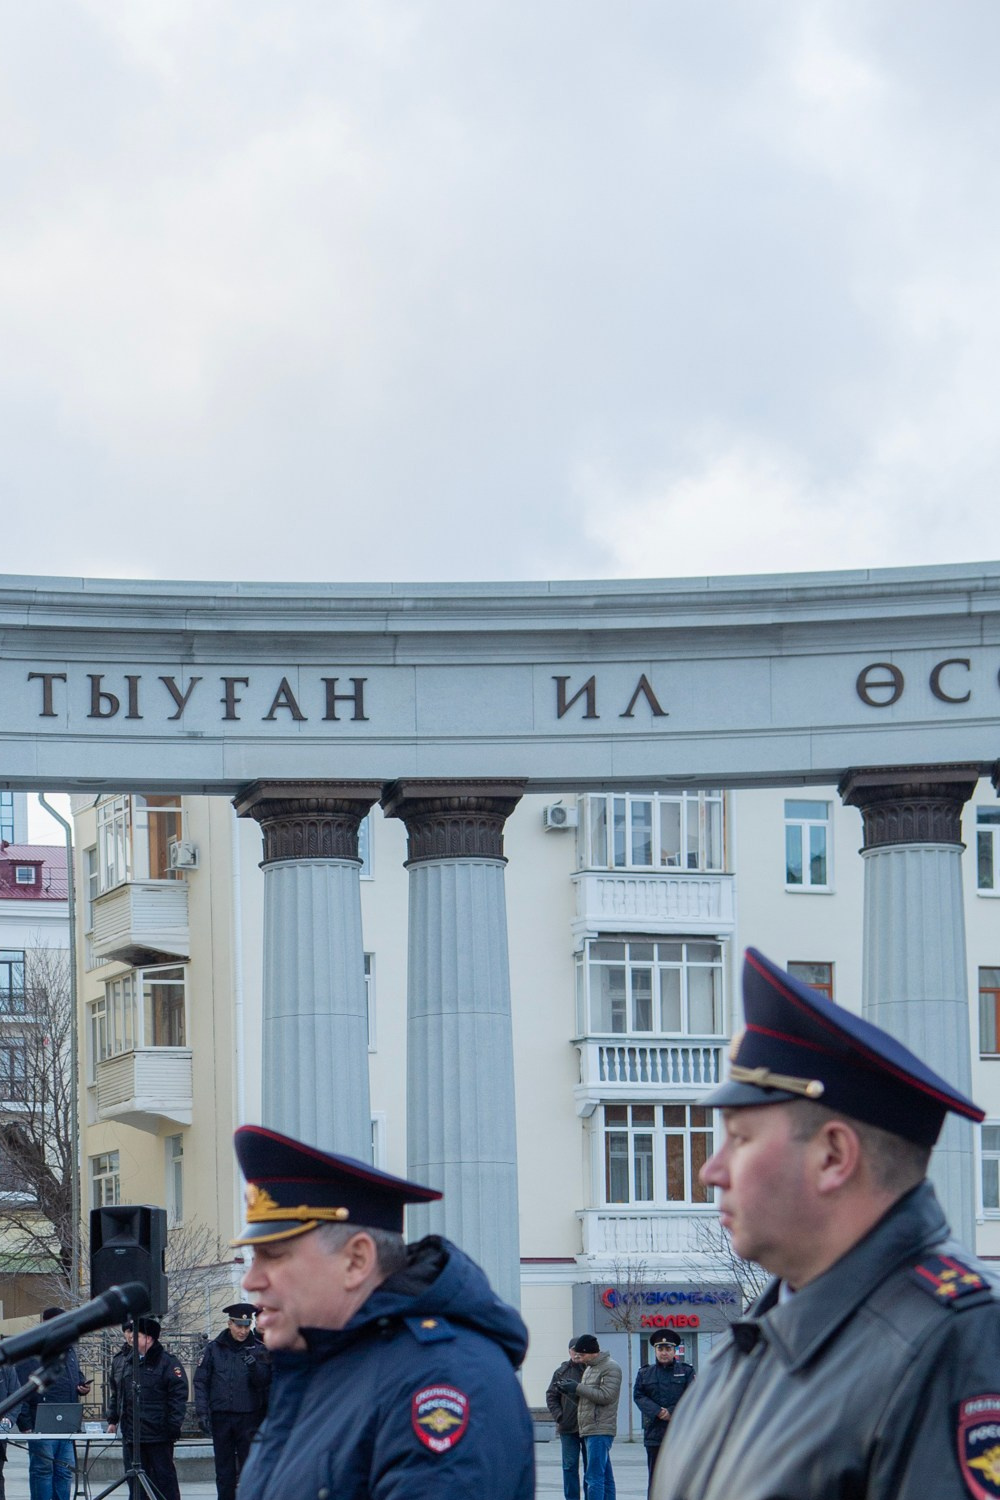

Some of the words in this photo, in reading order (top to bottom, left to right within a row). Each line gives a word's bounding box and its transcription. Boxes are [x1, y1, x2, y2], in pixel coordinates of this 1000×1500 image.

[26, 671, 371, 722] ТЫУҒАН
[550, 673, 671, 720] ИЛ
[855, 657, 1000, 708] ӨС
